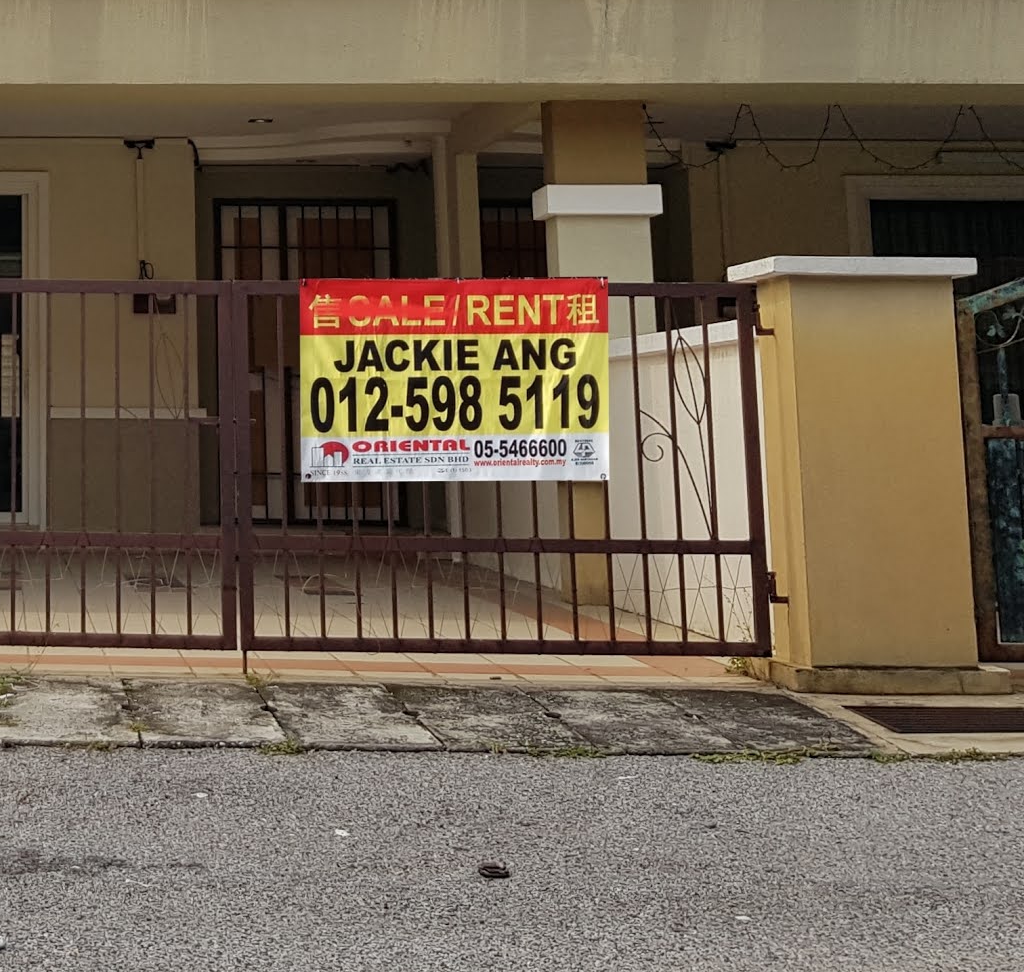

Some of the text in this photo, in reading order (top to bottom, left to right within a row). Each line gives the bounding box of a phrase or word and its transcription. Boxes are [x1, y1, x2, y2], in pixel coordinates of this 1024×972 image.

[566, 293, 600, 326] 租
[333, 337, 577, 373] JACKIE ANG
[310, 373, 600, 434] 012-598 5119
[352, 438, 471, 454] ORIENTAL
[473, 438, 567, 459] 05-5466600
[353, 455, 470, 466] REAL ESTATE SDN BHD
